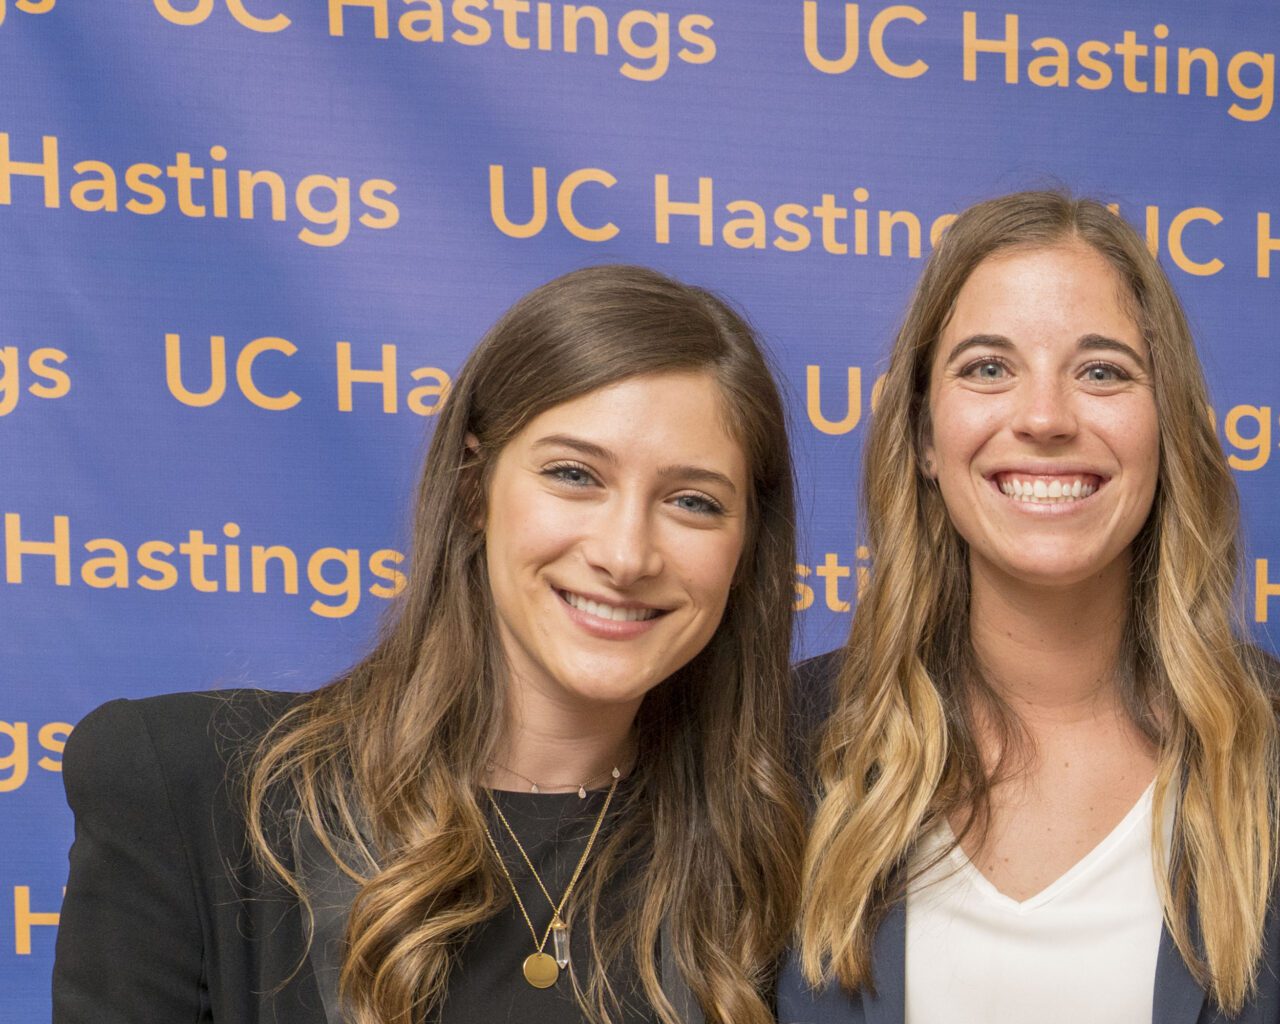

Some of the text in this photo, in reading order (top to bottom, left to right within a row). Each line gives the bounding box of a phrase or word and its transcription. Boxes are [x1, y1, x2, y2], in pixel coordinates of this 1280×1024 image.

[803, 0, 930, 79] UC
[0, 131, 400, 247] Hastings
[489, 164, 620, 242] UC
[164, 333, 302, 411] UC
[806, 364, 889, 435] U
[5, 512, 408, 618] Hastings
